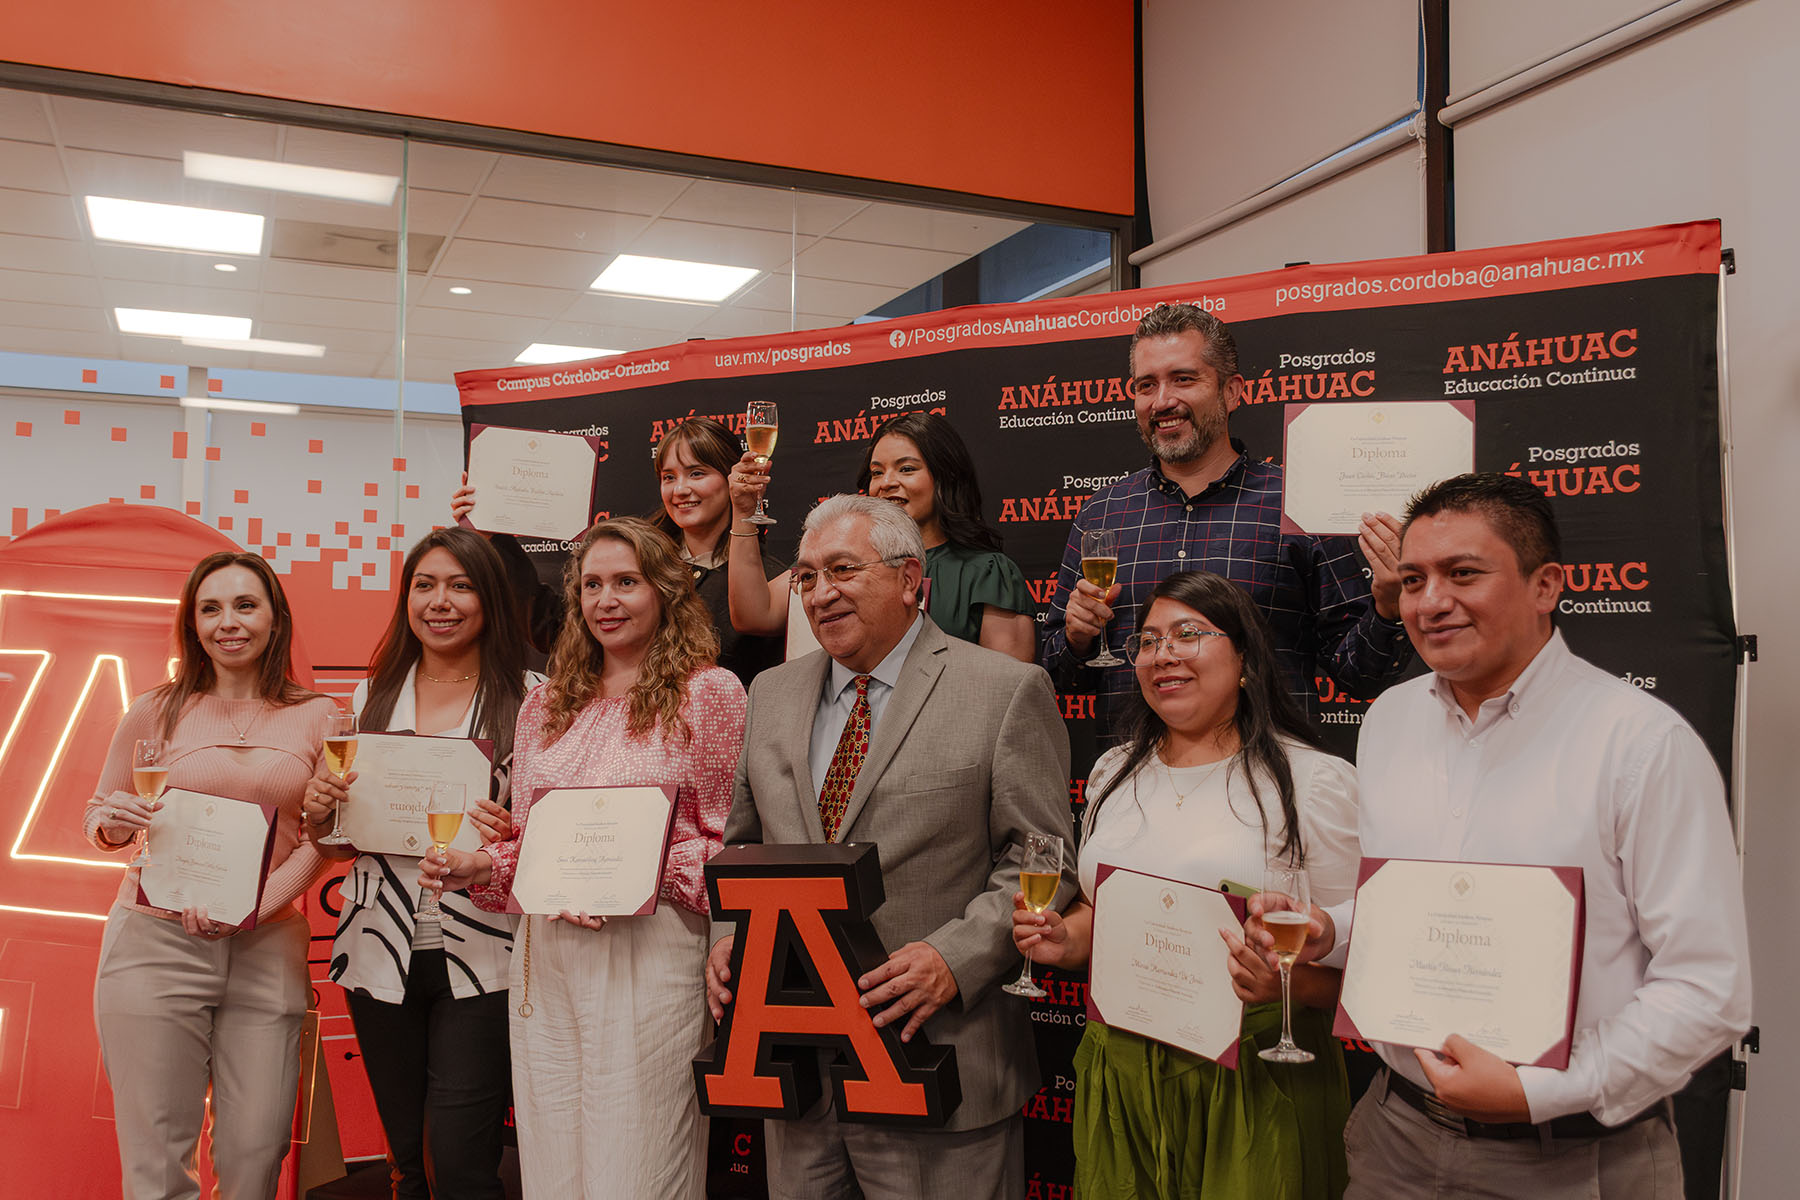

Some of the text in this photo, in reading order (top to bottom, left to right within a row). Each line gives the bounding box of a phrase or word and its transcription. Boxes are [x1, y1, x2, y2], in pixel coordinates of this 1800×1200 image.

[1275, 249, 1645, 306] posgrados.cordoba@anahuac.mx
[715, 341, 851, 368] uav.mx/posgrados
[1280, 349, 1376, 370] Posgrados
[1443, 328, 1638, 374] ANÁHUAC
[496, 359, 670, 392] Campus Córdoba-Orizaba
[1444, 367, 1636, 395] Educación Continua
[871, 389, 946, 409] Posgrados
[1000, 407, 1136, 429] Educación Continu
[1352, 447, 1407, 462] Diploma
[1528, 440, 1640, 464] Posgrados
[512, 465, 549, 480] Diploma
[1559, 598, 1652, 614] Continua
[186, 834, 222, 851] Diploma
[574, 832, 615, 847] Diploma
[1145, 932, 1192, 956] Diploma
[1427, 926, 1491, 948] Diploma
[704, 877, 928, 1116] A
